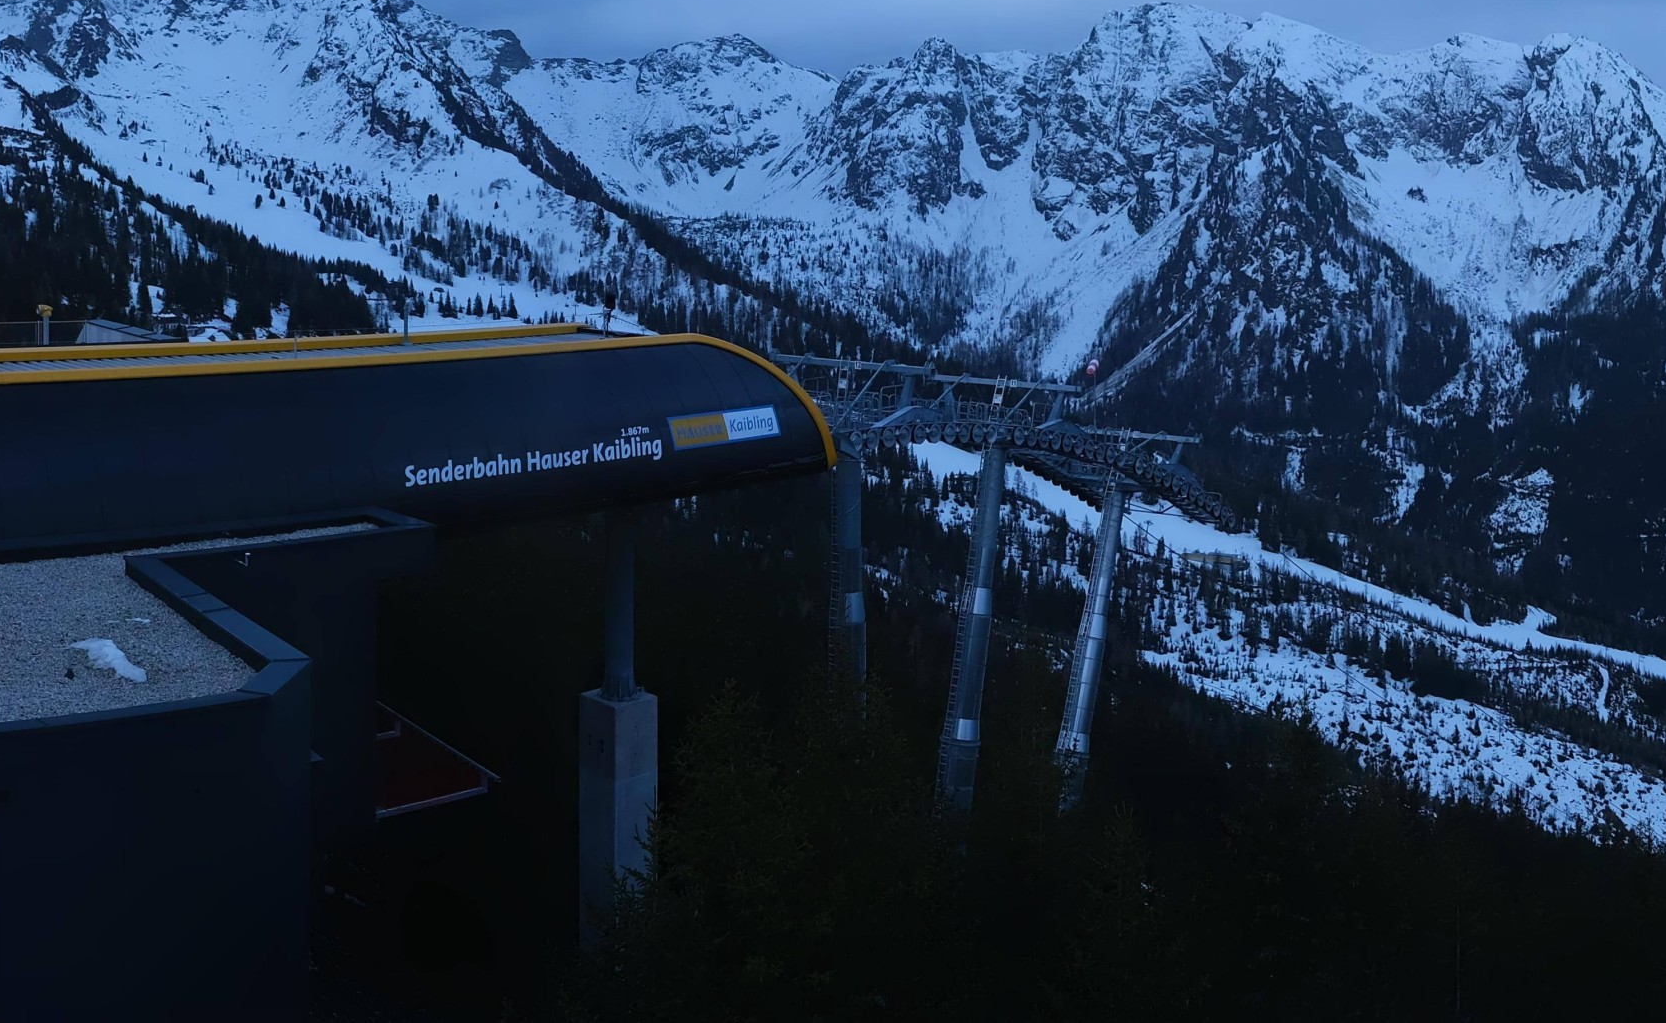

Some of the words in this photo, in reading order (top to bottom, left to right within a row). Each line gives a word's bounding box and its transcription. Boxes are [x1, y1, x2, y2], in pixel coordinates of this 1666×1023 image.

[620, 425, 650, 437] 1.867m
[729, 415, 774, 433] Kaibling
[404, 453, 522, 488] Senderbahn
[526, 446, 589, 472] Hauser
[592, 436, 663, 464] Kaibling
